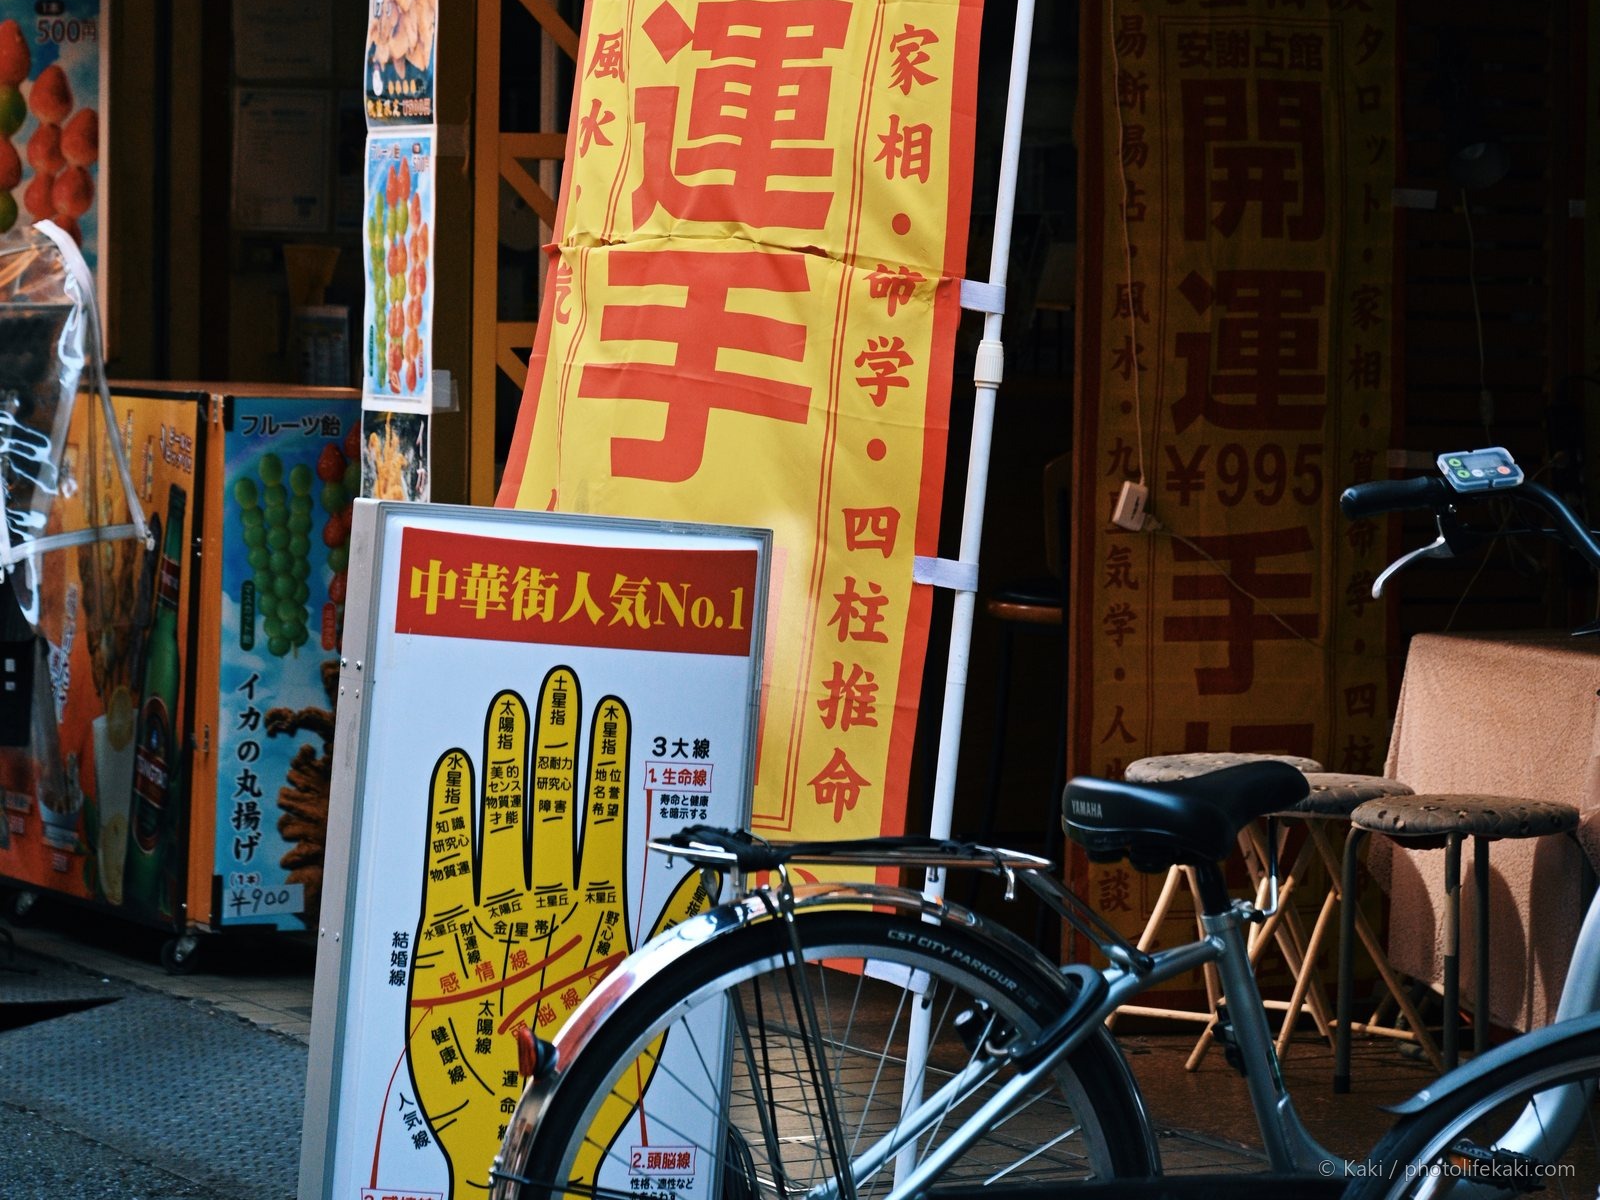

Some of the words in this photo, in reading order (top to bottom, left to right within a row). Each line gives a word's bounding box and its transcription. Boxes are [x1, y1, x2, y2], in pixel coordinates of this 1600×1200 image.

[1177, 29, 1324, 72] 安謝占館
[1171, 78, 1328, 436] 開運
[240, 413, 341, 438] フルーツ飴
[1164, 443, 1323, 507] ¥995
[409, 559, 745, 631] 中華街人気No.1
[550, 675, 568, 727] 土星指
[497, 700, 516, 751] 太陽指
[602, 704, 620, 756] 木星指
[652, 736, 710, 759] 3大線
[230, 672, 262, 866] イカの丸揚げ
[490, 765, 519, 779] 美的
[537, 755, 573, 771] 忍耐力
[444, 754, 464, 805] 水星指
[536, 776, 572, 792] 研究心
[594, 768, 621, 783] 地位
[488, 780, 521, 794] センス
[593, 785, 620, 800] 名誉
[485, 794, 522, 810] 物質運
[538, 799, 568, 814] 障害
[592, 802, 619, 817] 希望
[660, 793, 709, 807] 寿命と健康
[1071, 799, 1104, 820] YAMAHA
[489, 811, 519, 825] 才能
[659, 807, 707, 820] を暗示する
[435, 817, 466, 834] 知識
[432, 836, 470, 853] 研究心
[429, 863, 471, 882] 物質運
[230, 887, 290, 916] ¥900
[535, 893, 569, 909] 土星丘
[585, 890, 617, 904] 木星丘
[487, 902, 523, 919] 太陽丘
[424, 921, 459, 941] 水星丘
[493, 919, 548, 939] 金星帯
[595, 911, 619, 956] 野心線
[459, 922, 481, 964] 財運線
[388, 931, 410, 987] 結婚線
[887, 929, 916, 941] CST
[916, 936, 951, 954] CITY
[952, 949, 1018, 991] PARKOUR
[439, 950, 529, 995] 感情線
[474, 1000, 495, 1056] 太陽線
[430, 1023, 467, 1086] 健康線
[399, 1090, 432, 1150] 人気線
[632, 1151, 690, 1169] 2.頭脳線
[630, 1177, 694, 1190] 性格、適性など
